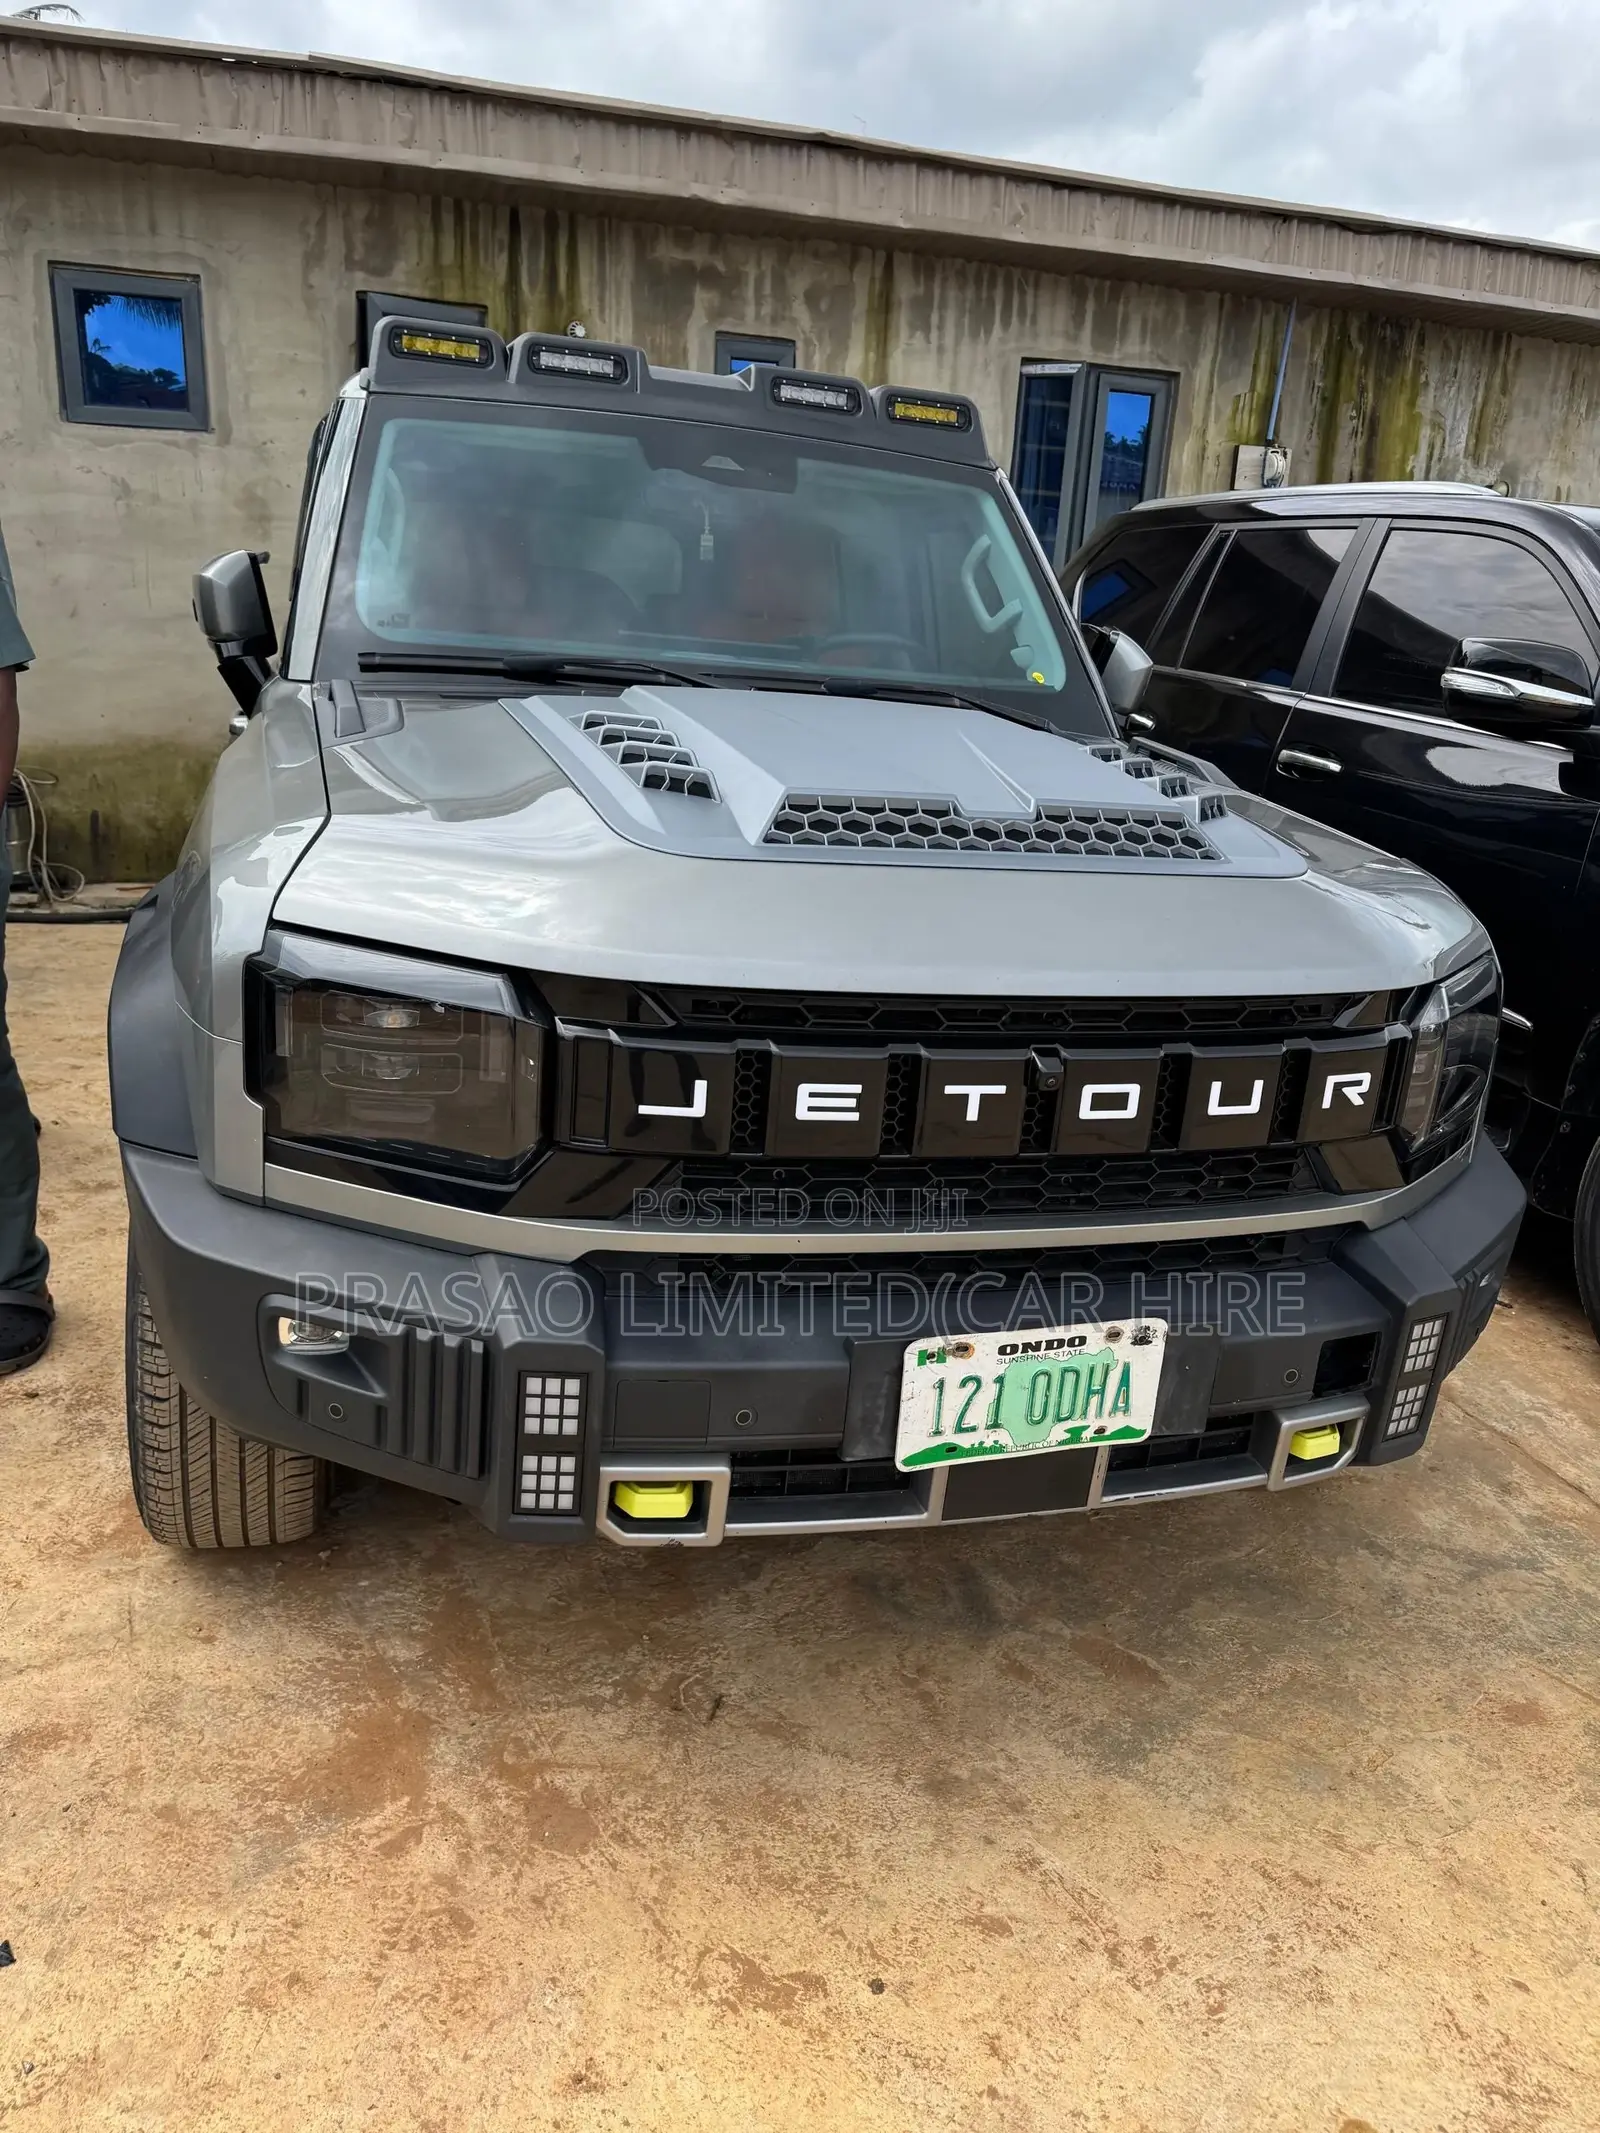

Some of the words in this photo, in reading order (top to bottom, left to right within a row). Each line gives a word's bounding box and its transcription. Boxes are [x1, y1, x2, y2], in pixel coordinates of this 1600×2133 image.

[637, 1071, 1373, 1122] JETOUR
[996, 1353, 1051, 1366] SUNSHINE
[1054, 1348, 1086, 1359] STATE
[997, 1335, 1088, 1356] ONDO
[927, 1374, 1006, 1438] 121
